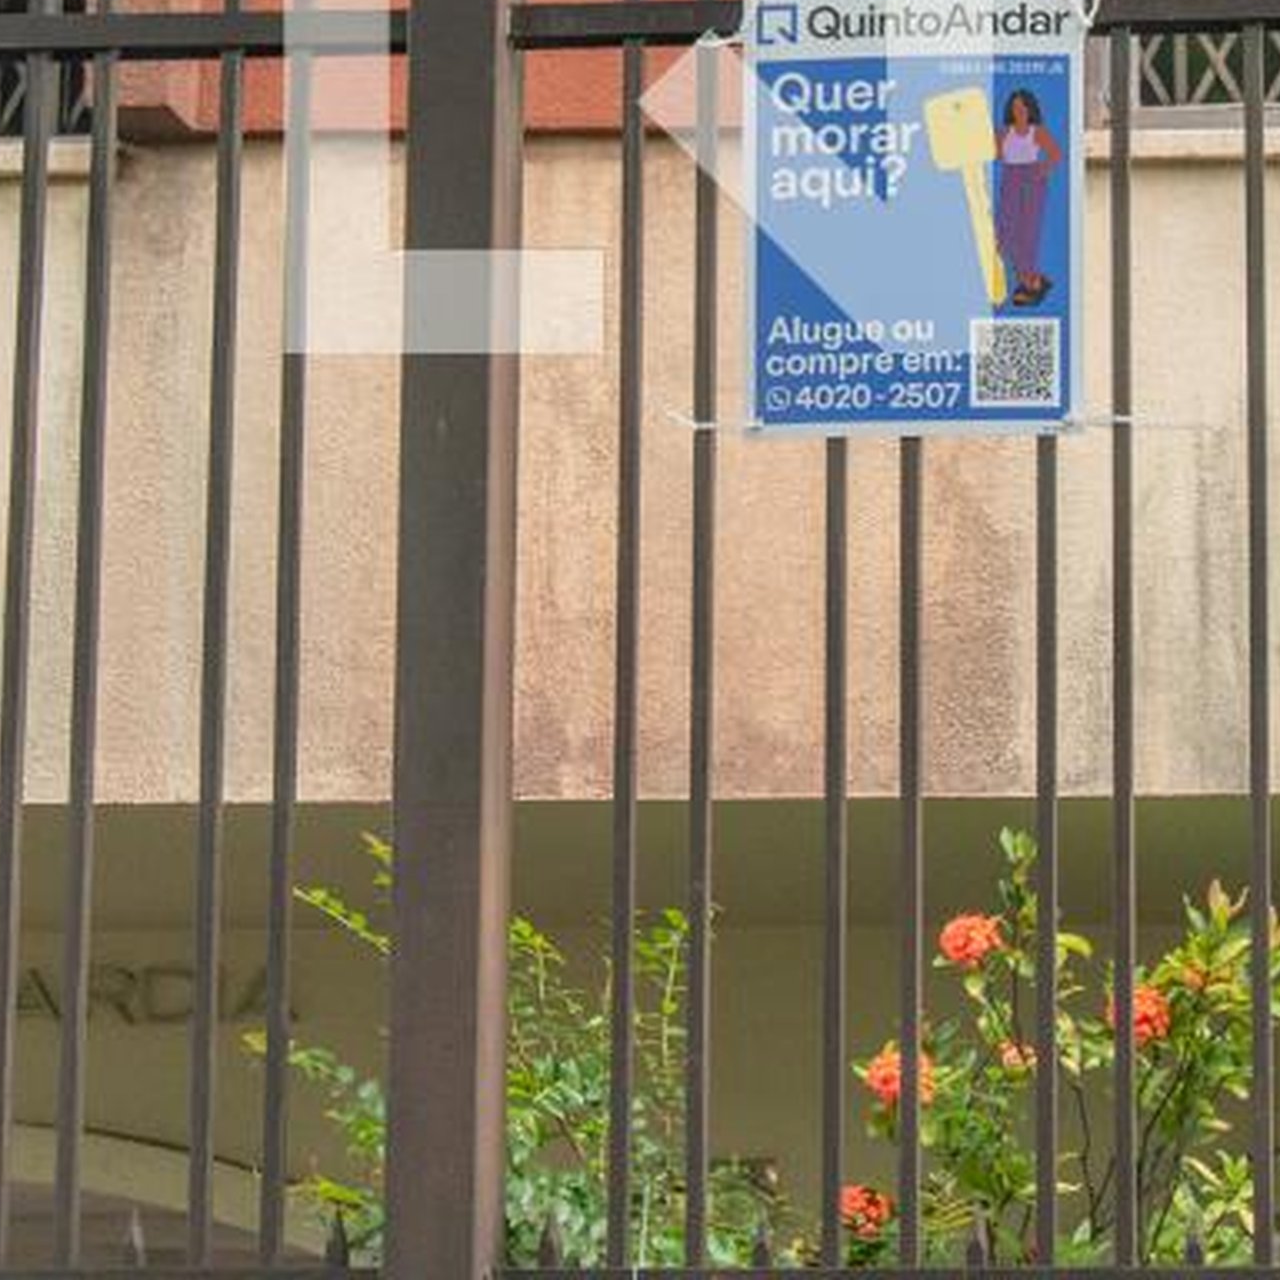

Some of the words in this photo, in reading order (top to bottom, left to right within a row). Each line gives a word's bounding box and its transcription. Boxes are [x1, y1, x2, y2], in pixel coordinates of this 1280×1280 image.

[807, 3, 1070, 42] QuintoAndar
[771, 72, 897, 114] Quer
[771, 122, 922, 156] morar
[771, 154, 908, 209] aqui?
[767, 315, 884, 350] Alugue
[892, 318, 935, 343] ou
[765, 350, 894, 380] compre
[902, 349, 963, 373] em:
